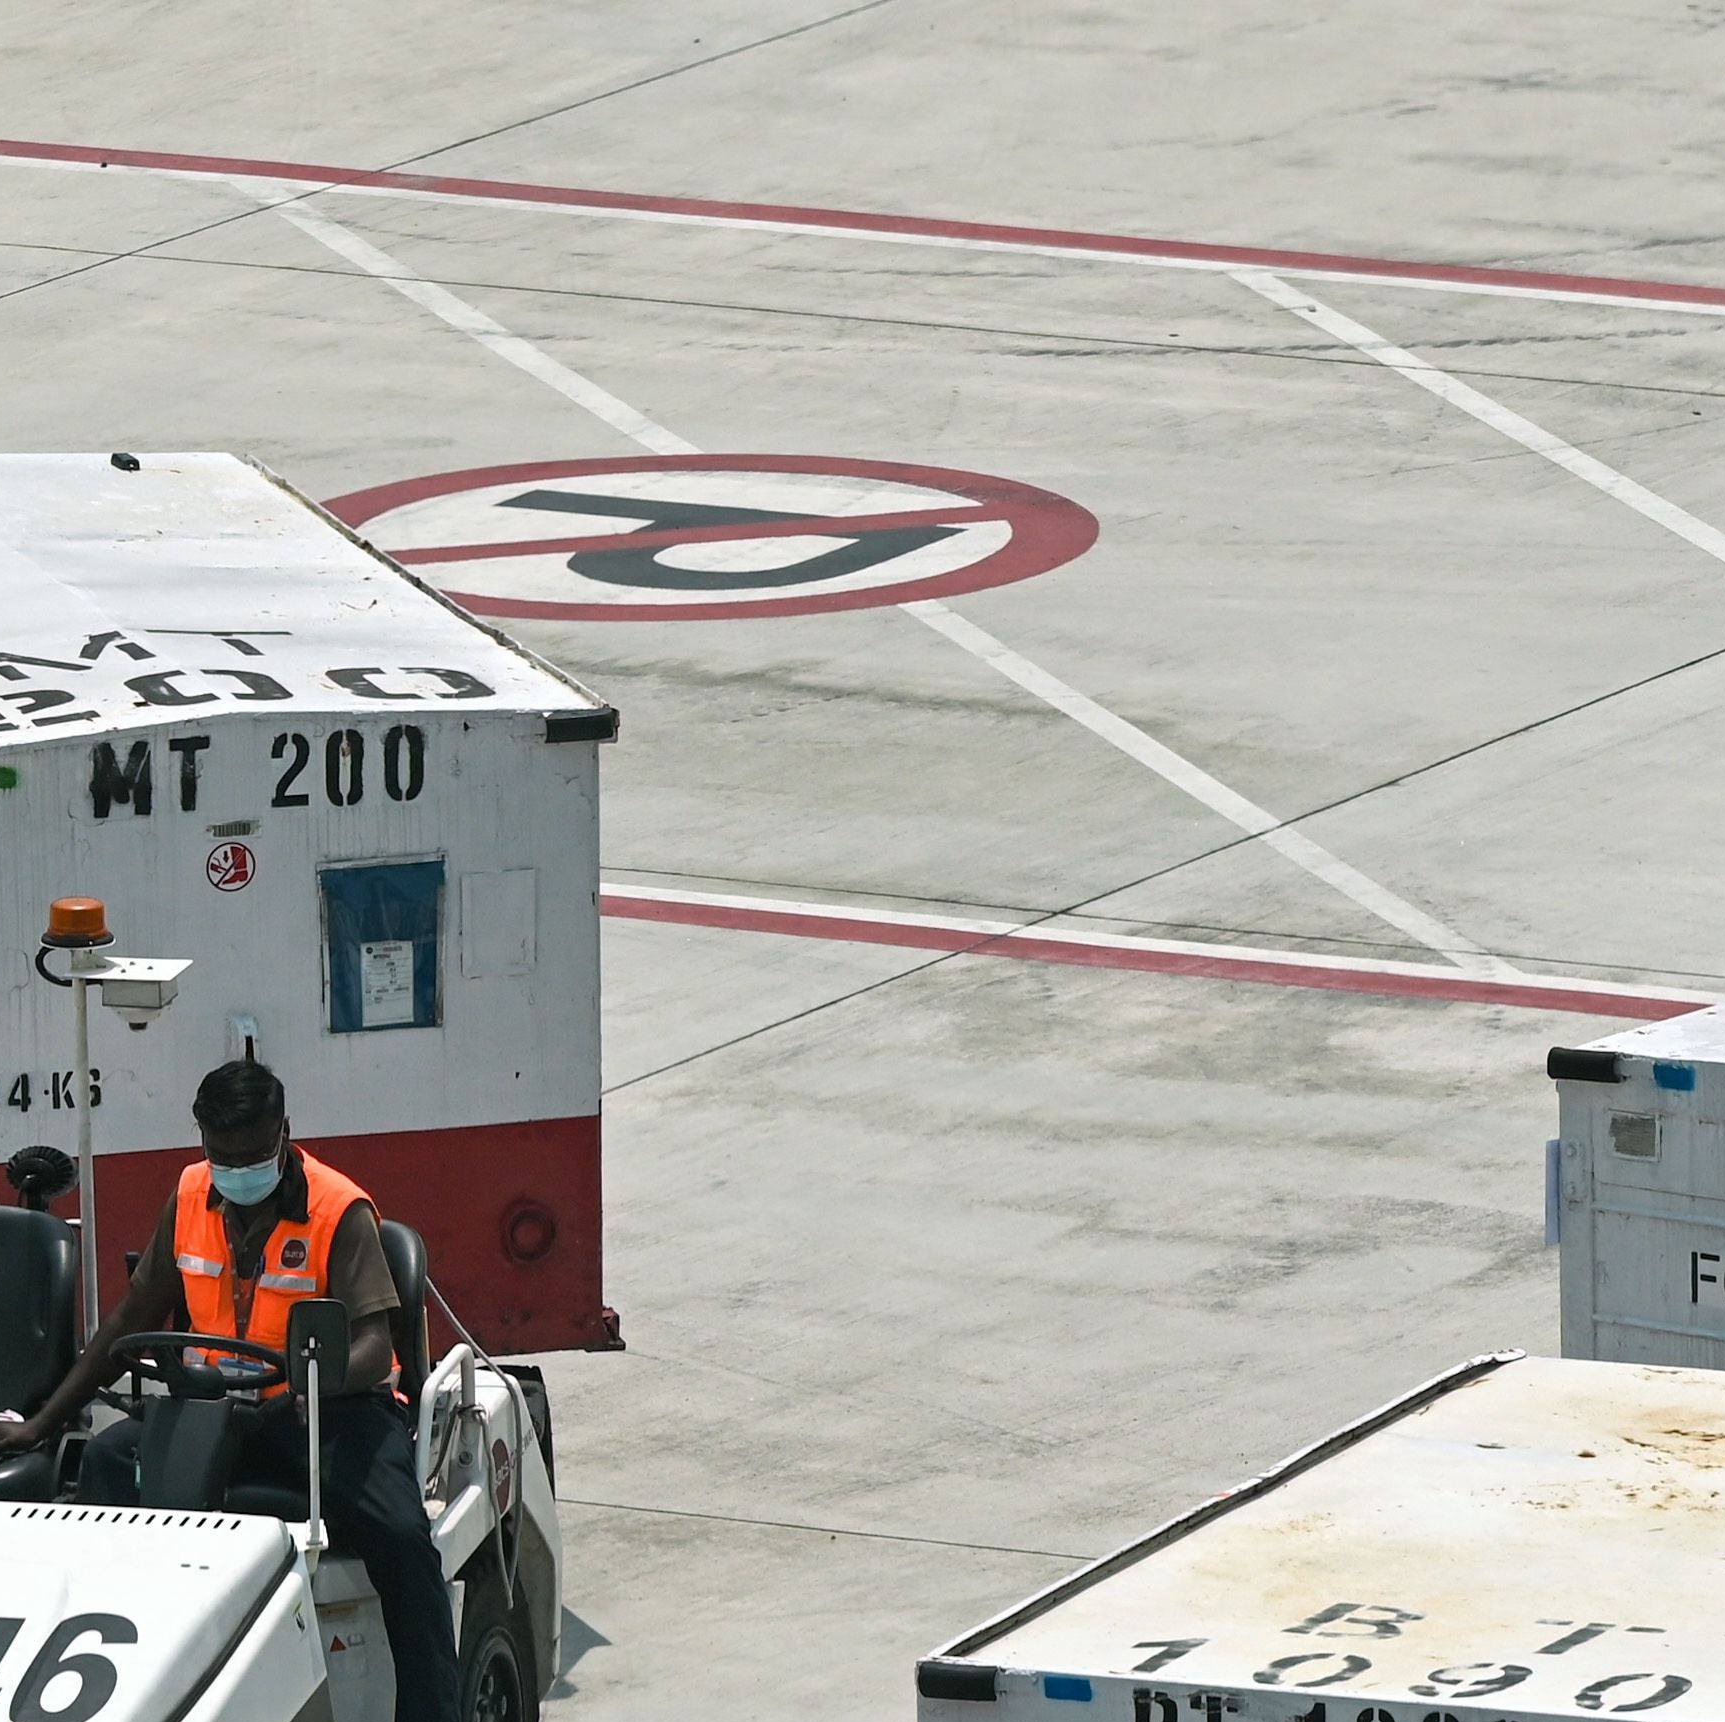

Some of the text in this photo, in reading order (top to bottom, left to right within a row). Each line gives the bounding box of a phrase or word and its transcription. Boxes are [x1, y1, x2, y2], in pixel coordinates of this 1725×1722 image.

[91, 724, 425, 818] MT 200
[1131, 1638, 1692, 1712] 1090
